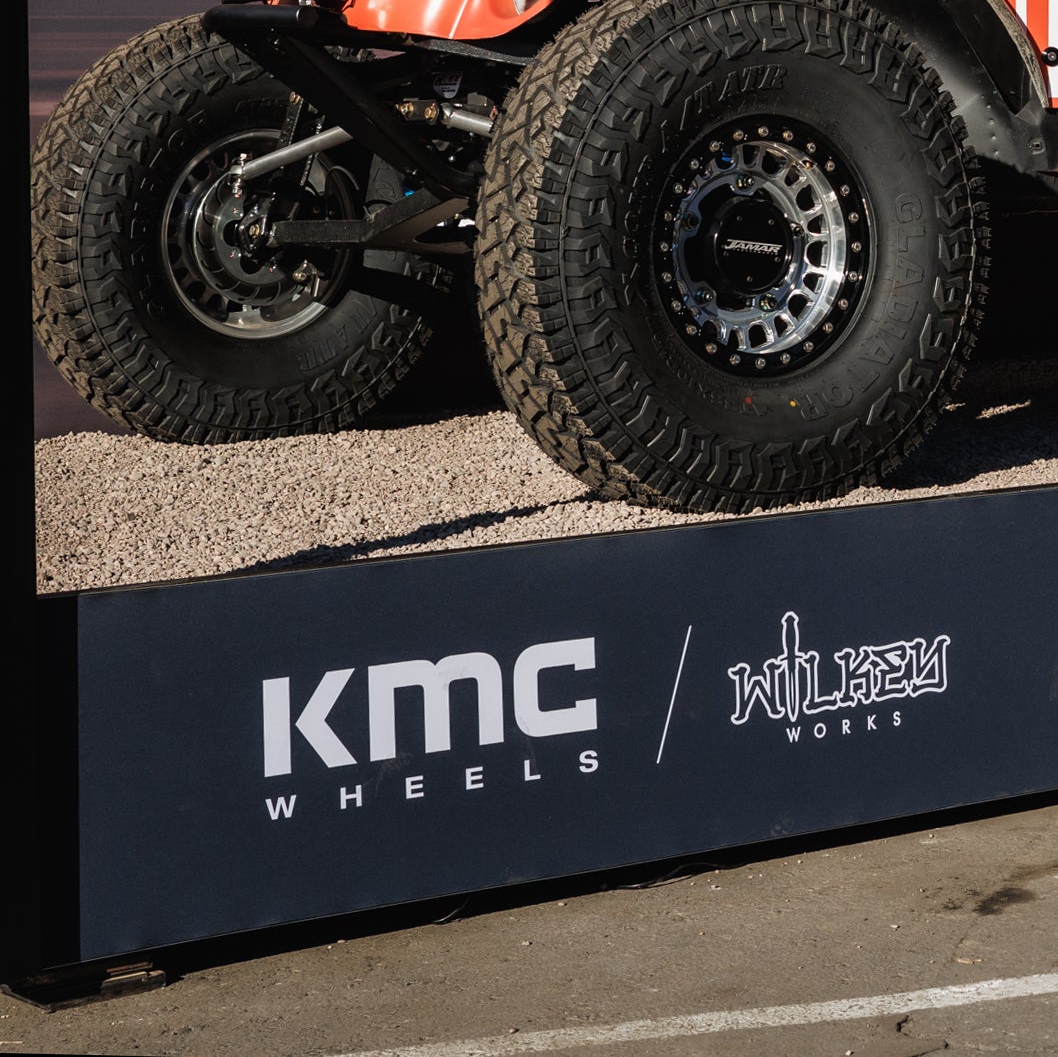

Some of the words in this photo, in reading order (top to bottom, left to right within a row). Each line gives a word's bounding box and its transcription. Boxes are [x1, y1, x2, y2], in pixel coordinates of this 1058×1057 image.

[794, 192, 926, 422] GLADIATOR
[786, 710, 902, 744] WORKS
[265, 750, 599, 821] WHEELS
